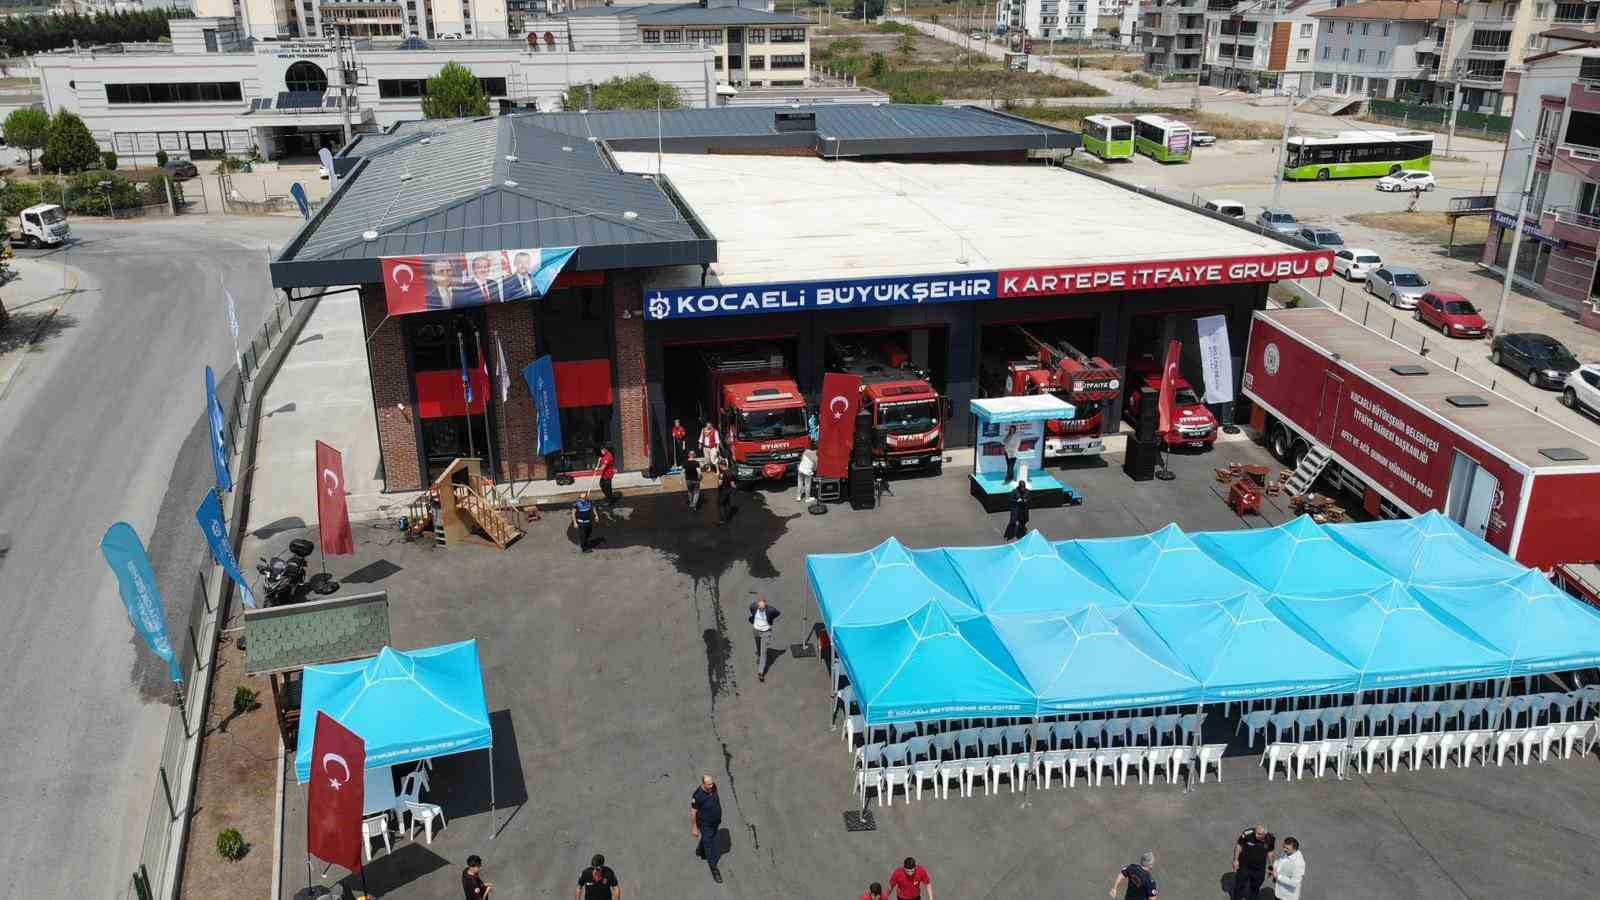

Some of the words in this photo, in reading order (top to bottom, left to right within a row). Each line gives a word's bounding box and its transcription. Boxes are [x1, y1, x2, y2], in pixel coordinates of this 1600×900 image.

[816, 278, 991, 305] BÜYÜKŞEHİR
[1003, 271, 1126, 294] KARTEPE
[1228, 259, 1309, 280] GRUBU
